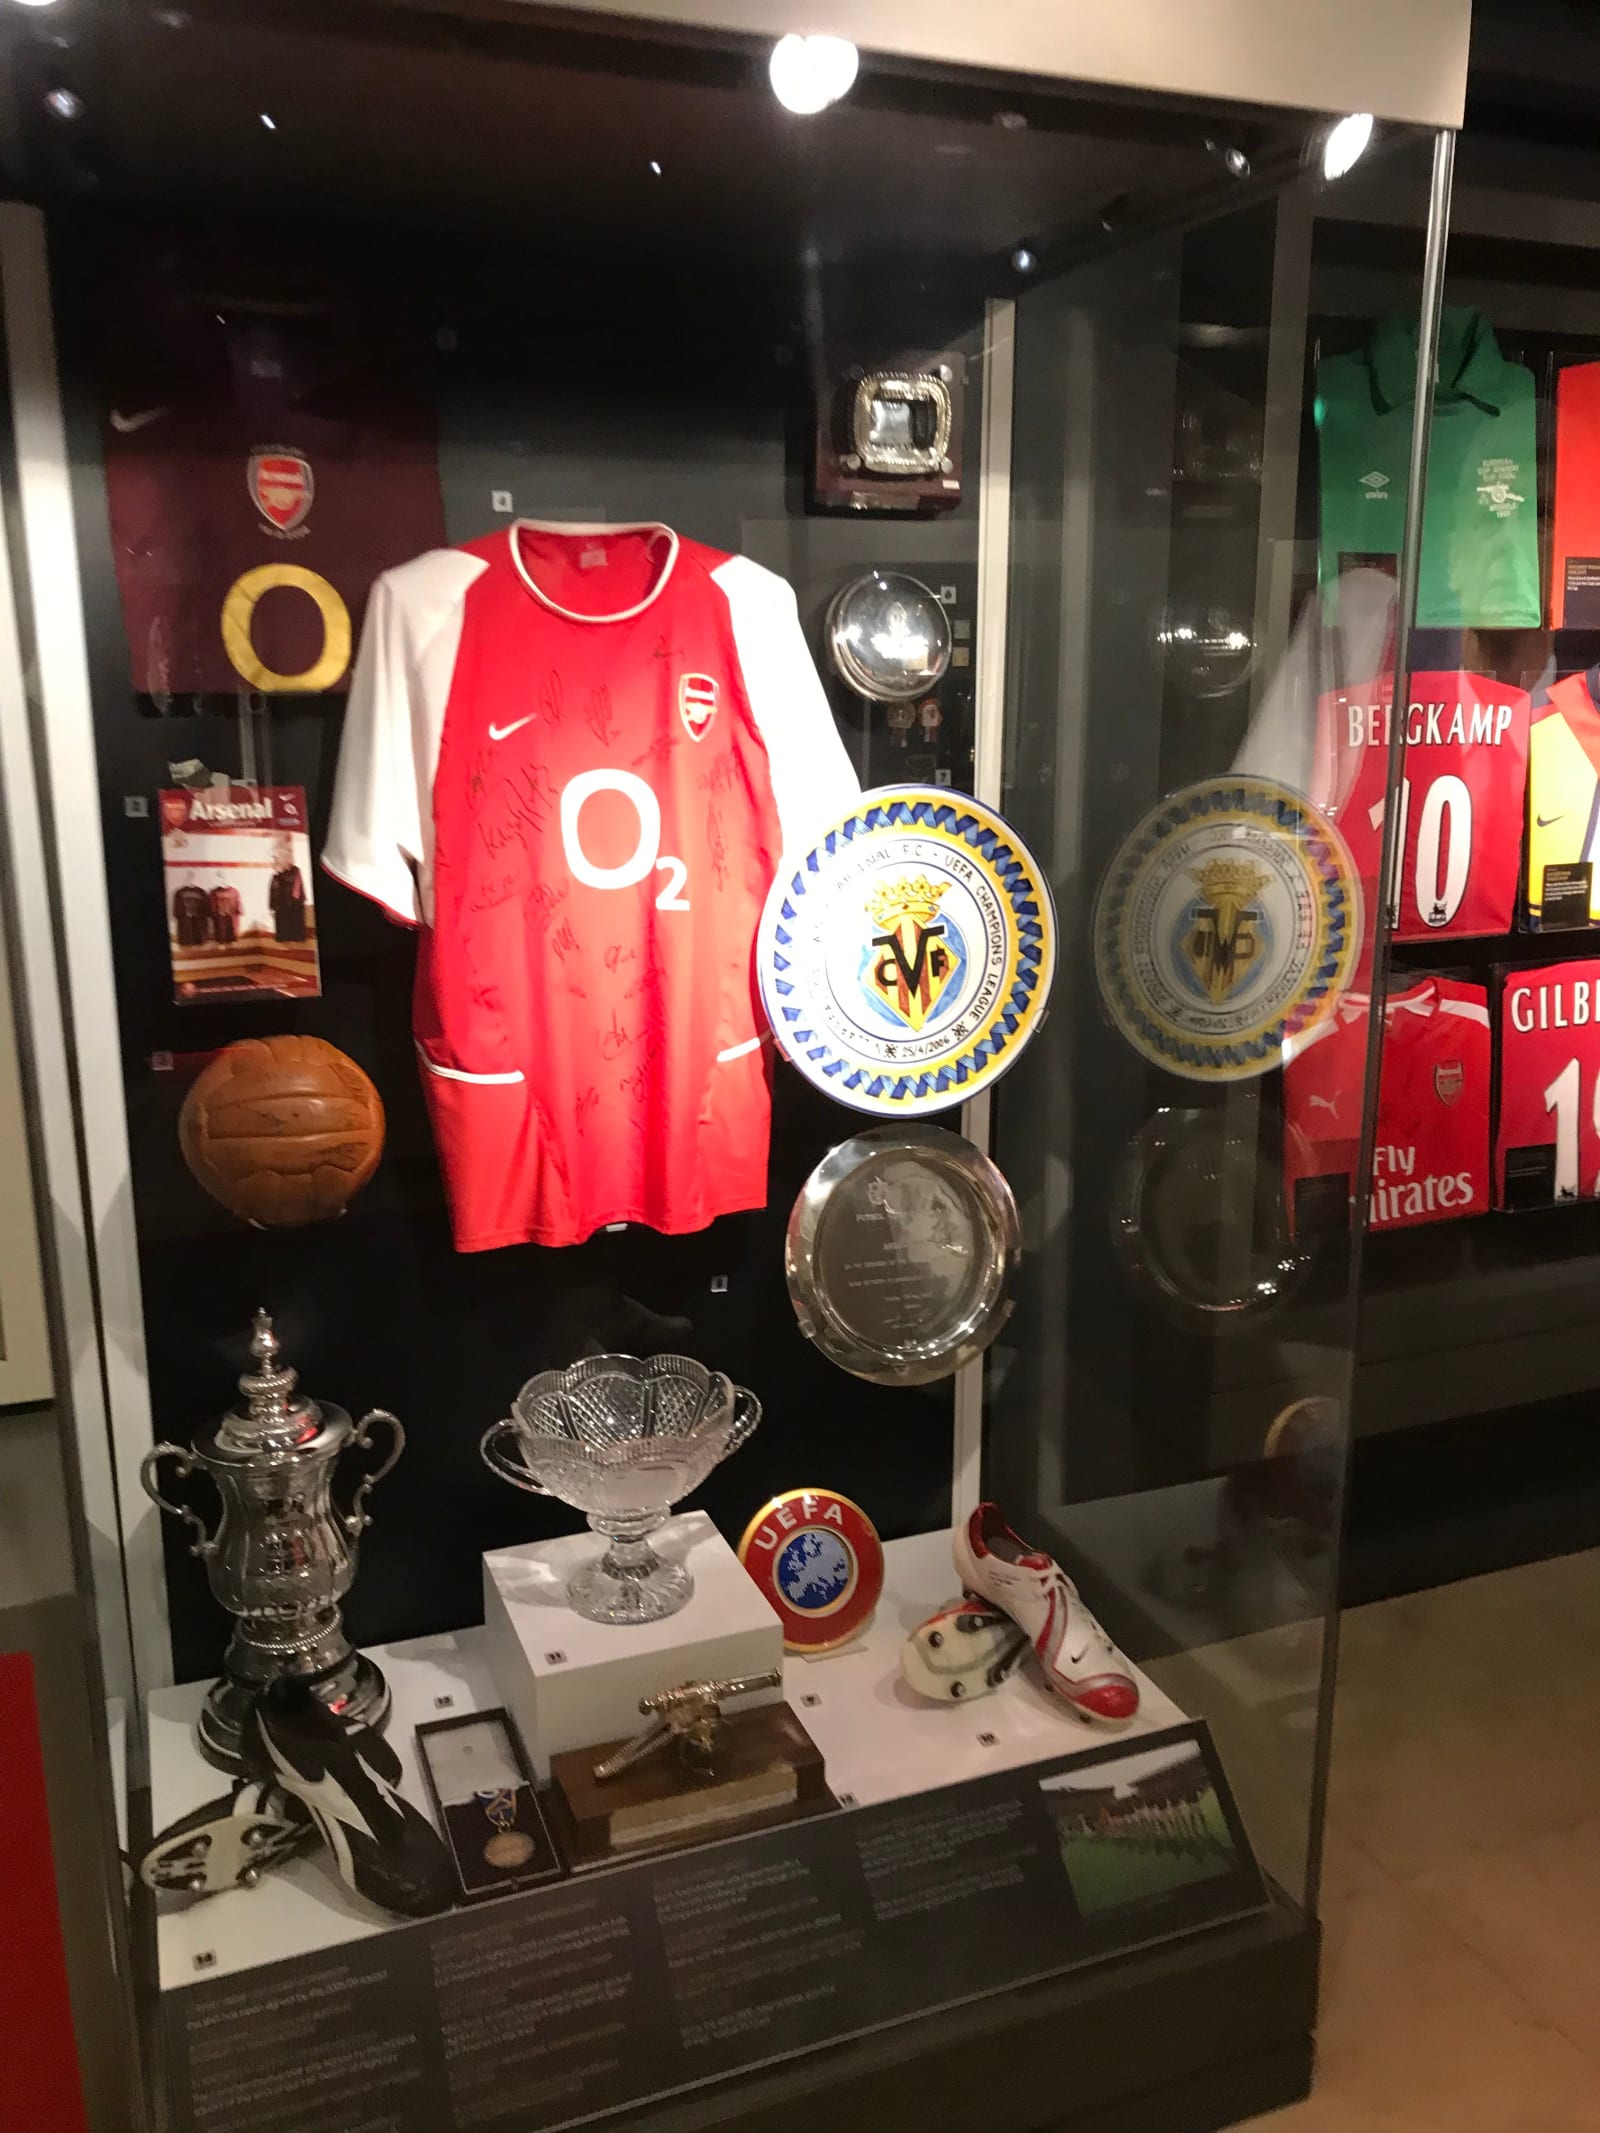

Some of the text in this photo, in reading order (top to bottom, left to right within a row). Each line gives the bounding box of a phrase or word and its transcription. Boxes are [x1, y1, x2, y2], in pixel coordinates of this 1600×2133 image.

[189, 797, 273, 821] Arsenal
[1367, 774, 1473, 929] 10
[944, 855, 1004, 1021] UEFA CHAMPIONS LEAGUE
[1372, 1144, 1416, 1177] Fly
[1369, 1172, 1474, 1224] irates
[753, 1499, 844, 1551] UEFA
